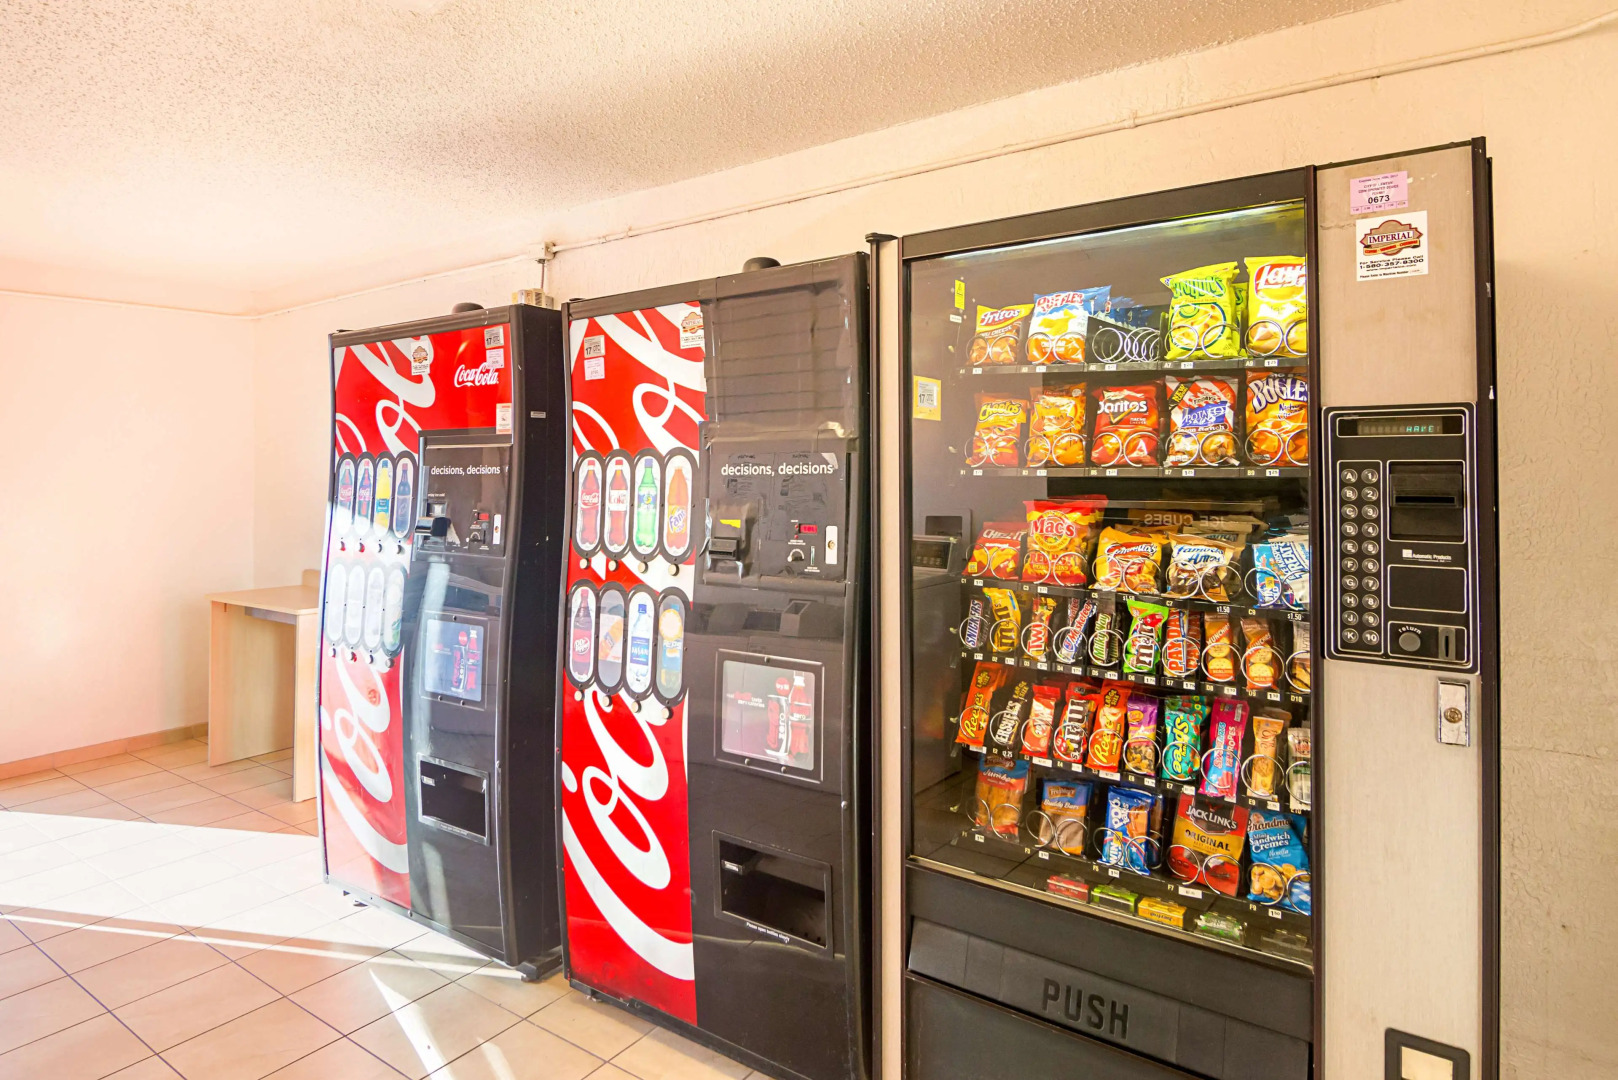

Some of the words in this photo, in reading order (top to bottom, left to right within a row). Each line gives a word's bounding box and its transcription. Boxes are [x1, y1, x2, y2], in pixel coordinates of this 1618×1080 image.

[1368, 194, 1390, 205] 0673
[1368, 231, 1413, 244] IMPERIAL
[980, 309, 1021, 326] Fritos
[454, 363, 499, 388] Coca-Cola
[978, 401, 1021, 422] Cheetos
[430, 466, 465, 476] decisions,
[466, 465, 500, 475] decisions
[721, 463, 775, 477] decisions,
[778, 462, 834, 475] decisions
[965, 599, 984, 648] SNICKERS
[1287, 613, 1302, 621] $1.50
[1398, 626, 1422, 635] return
[1094, 633, 1107, 660] Milky
[1185, 805, 1209, 822] JACK
[1185, 829, 1231, 852] ORIGINAL
[1249, 831, 1291, 846] Sandwich
[1252, 840, 1290, 854] Cremes
[1041, 977, 1130, 1040] PUSH
